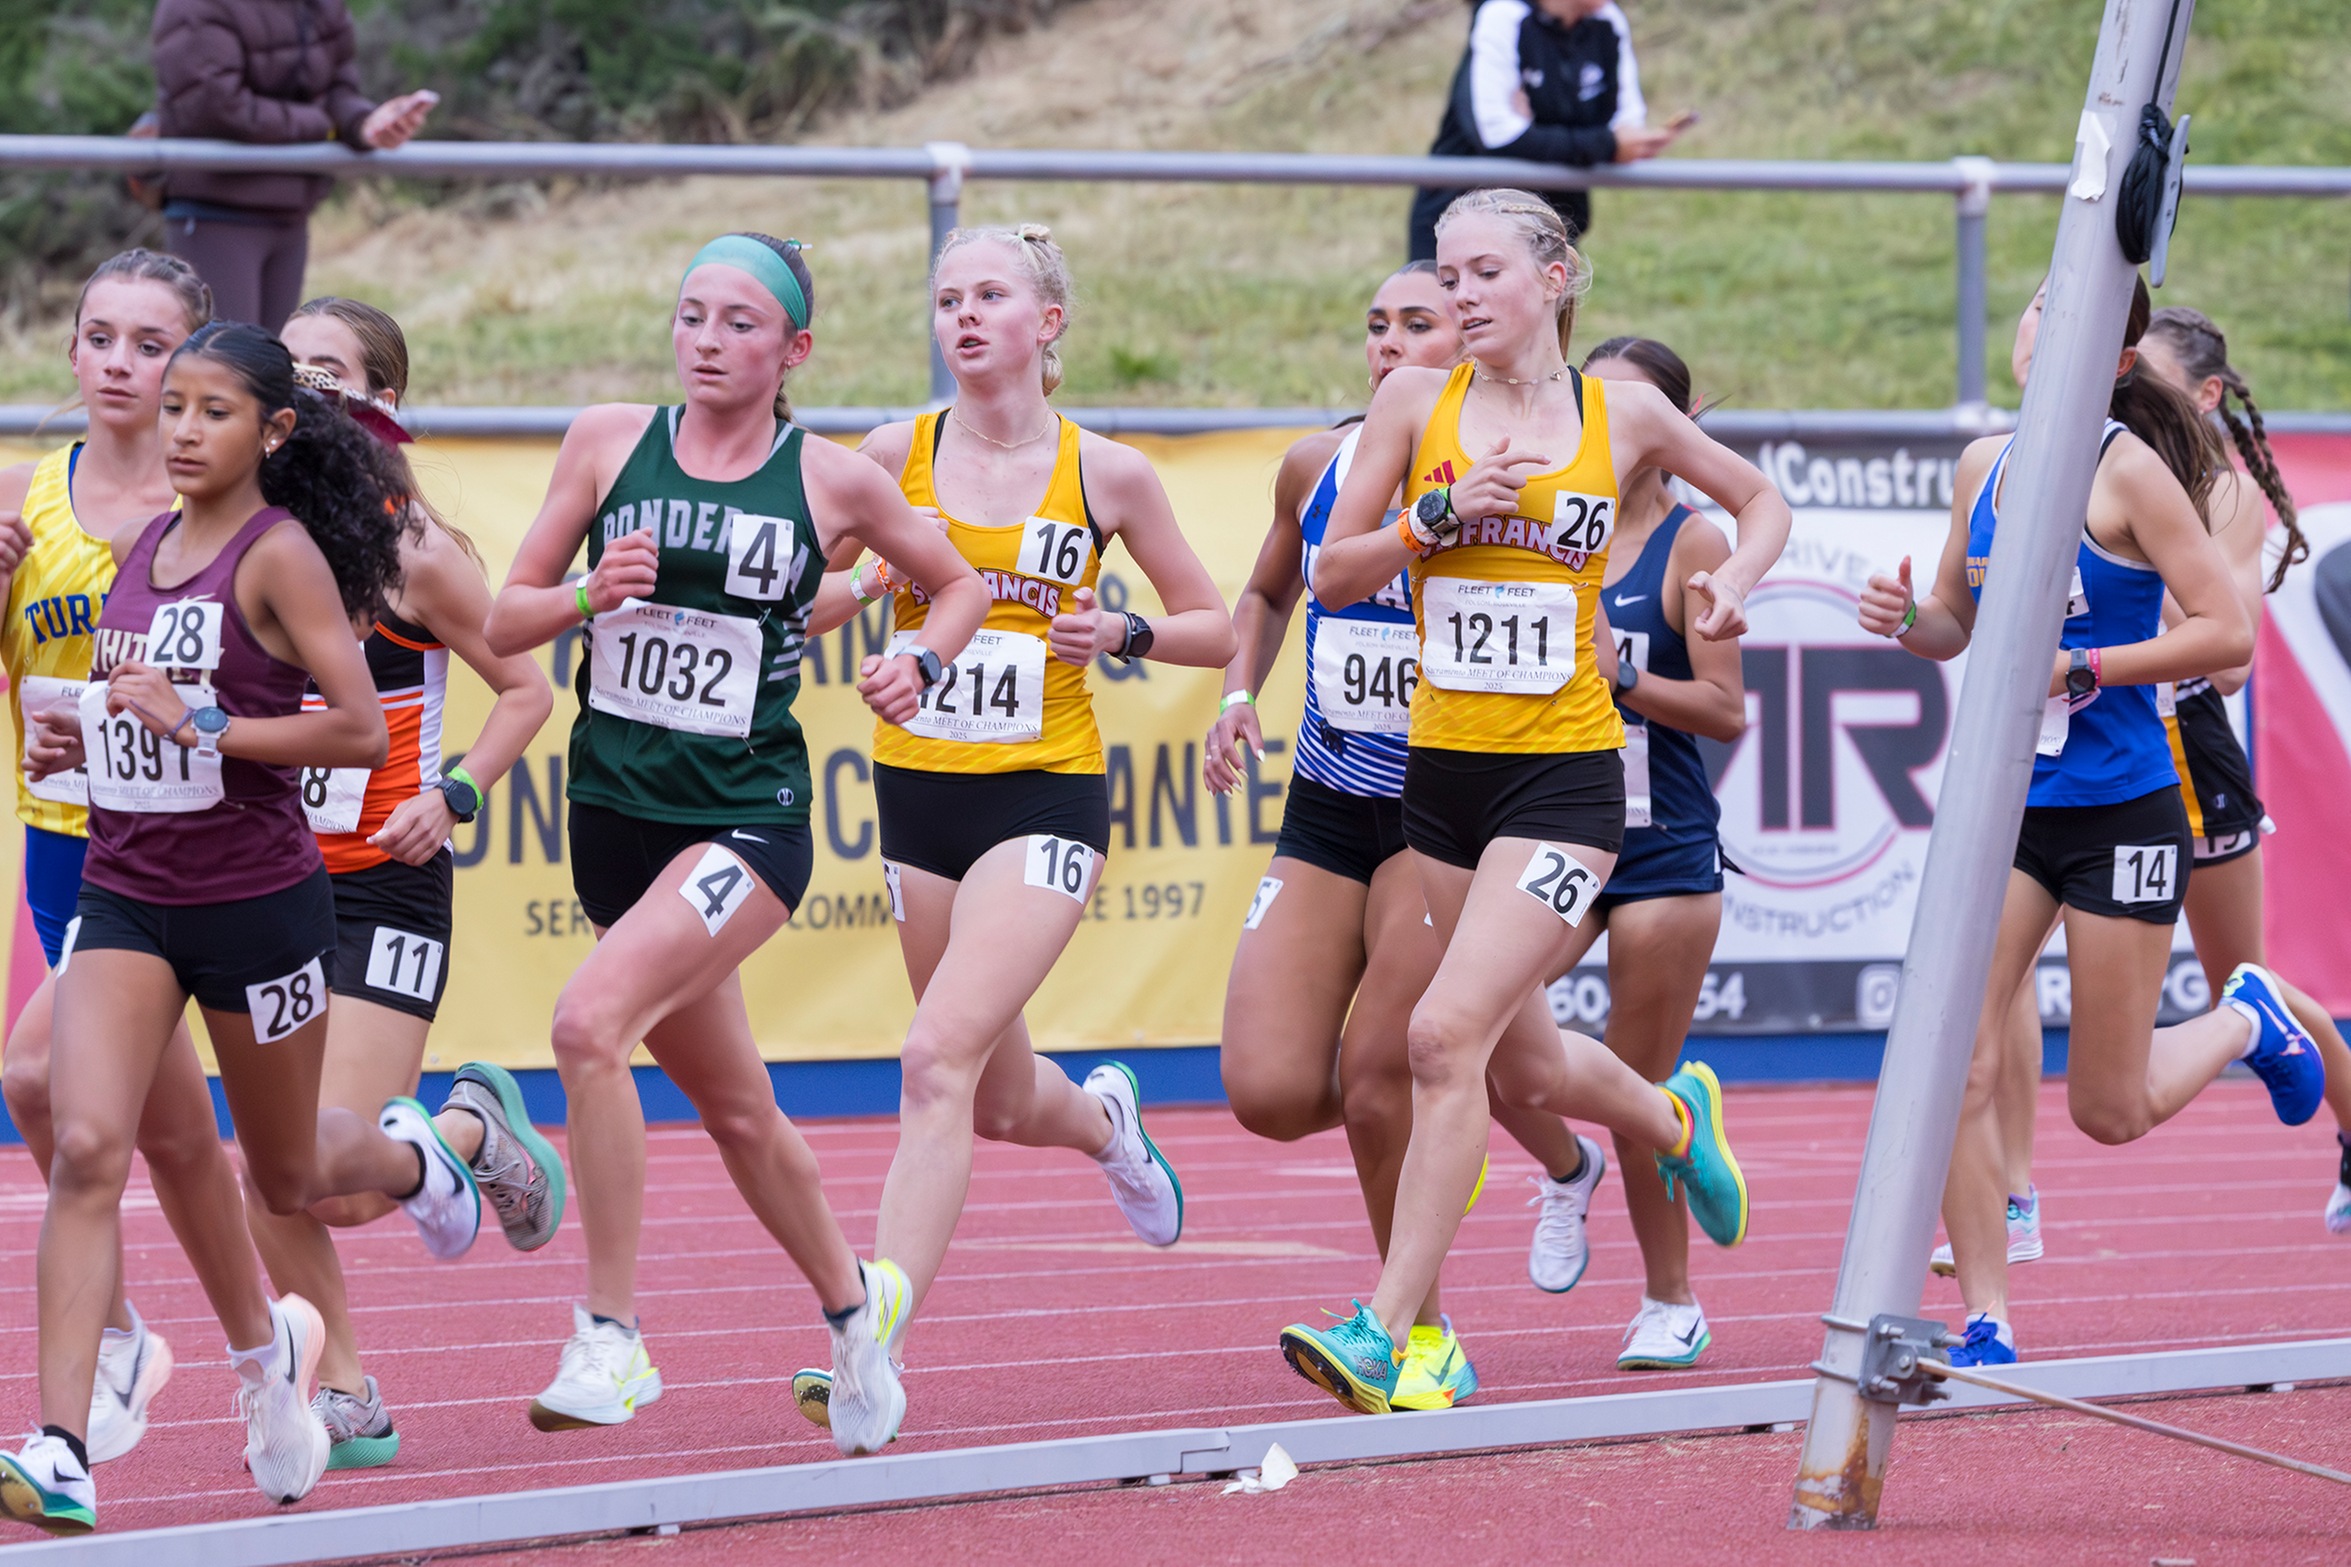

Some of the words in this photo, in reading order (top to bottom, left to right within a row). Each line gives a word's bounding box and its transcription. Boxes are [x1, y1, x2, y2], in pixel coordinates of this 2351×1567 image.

[1557, 497, 1608, 551] 26
[737, 521, 778, 594] 4
[1037, 523, 1083, 580] 16
[1458, 584, 1492, 595] FLEET
[1507, 587, 1536, 597] FEET
[25, 594, 107, 644] TUR
[153, 606, 205, 664] 28
[636, 607, 671, 621] FLEET
[686, 616, 717, 628] FEET
[973, 635, 1003, 645] FEET
[1349, 626, 1378, 637] FLEET
[1392, 630, 1417, 640] FEET
[1448, 612, 1549, 666] 1211
[61, 686, 84, 697] FLE
[619, 631, 733, 708] 1032
[1344, 653, 1418, 709] 946
[1425, 665, 1465, 676] Sacramento
[1468, 667, 1496, 678] MEET
[1496, 669, 1510, 679] OF
[1512, 670, 1572, 681] CHAMPIONS
[1483, 682, 1503, 690] 2025
[635, 699, 662, 712] MEET
[664, 704, 679, 715] OF
[681, 707, 747, 725] CHAMPIONS
[933, 716, 959, 727] MEET
[960, 719, 974, 729] OF
[976, 720, 1037, 732] CHAMPIONS
[949, 731, 967, 739] 2025
[1357, 710, 1380, 719] MEET
[1041, 837, 1083, 893] 16
[1525, 851, 1588, 915] 26
[2127, 850, 2167, 898] 14
[696, 864, 744, 919] 4
[1122, 881, 1206, 920] 1997
[386, 934, 430, 994] 11
[260, 972, 315, 1038] 28
[1354, 1355, 1388, 1382] HOKA
